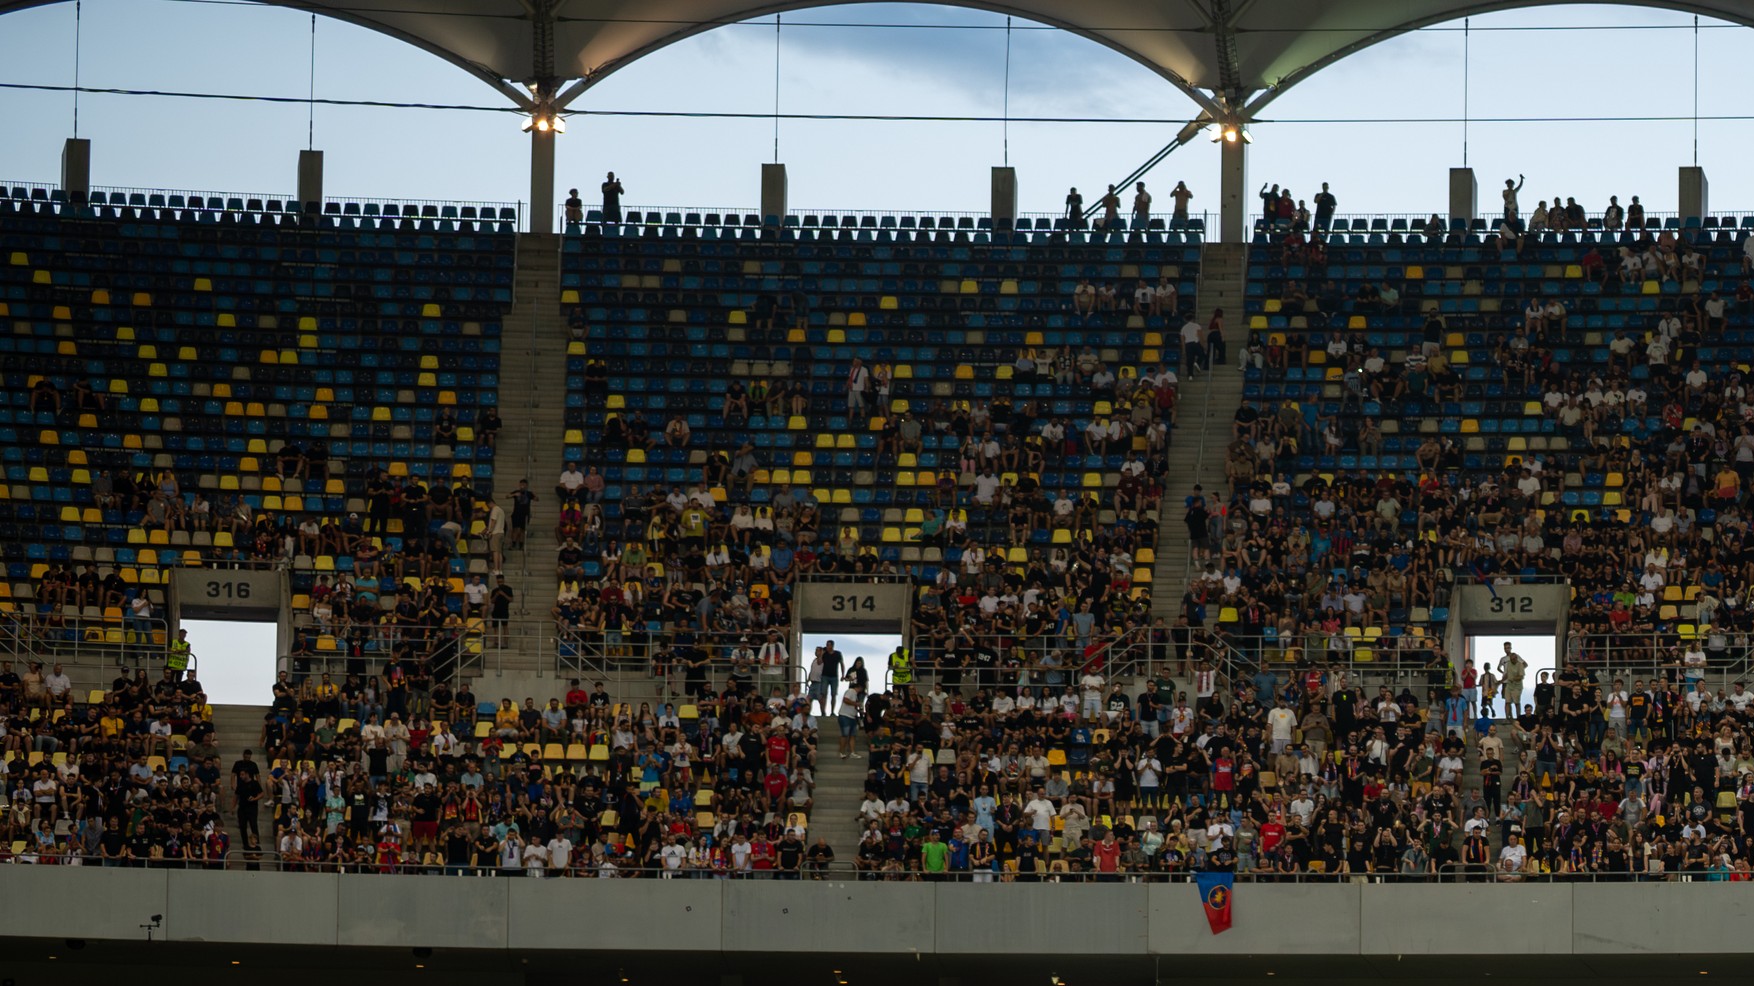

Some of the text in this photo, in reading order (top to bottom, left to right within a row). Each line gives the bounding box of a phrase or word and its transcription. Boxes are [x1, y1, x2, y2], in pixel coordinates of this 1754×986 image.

[206, 580, 251, 598] 316
[831, 595, 876, 611] 314
[1490, 596, 1533, 613] 312
